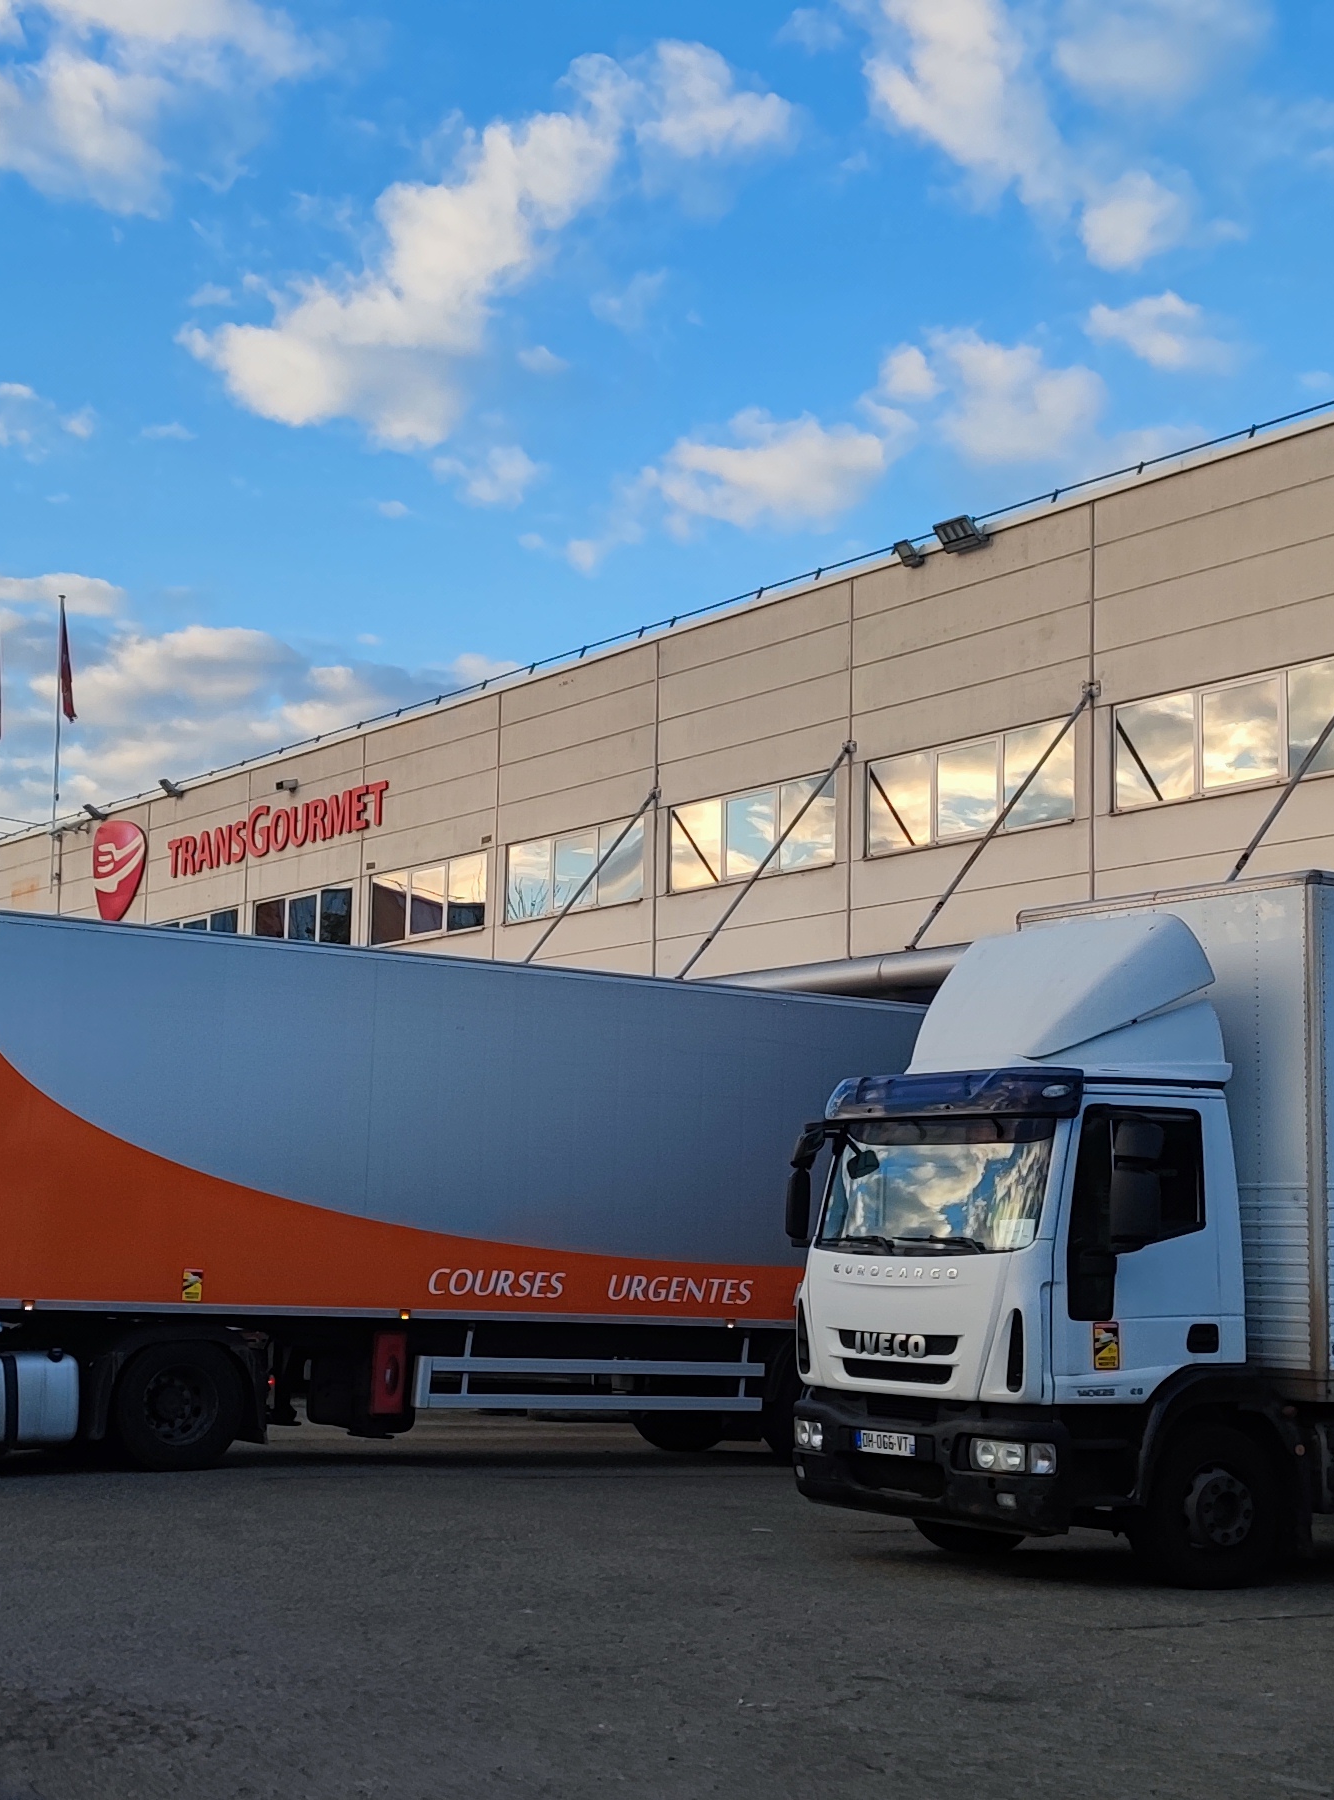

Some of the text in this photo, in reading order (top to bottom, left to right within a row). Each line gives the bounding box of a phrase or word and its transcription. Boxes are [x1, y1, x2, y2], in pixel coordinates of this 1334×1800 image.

[833, 1264, 959, 1280] EUROCARGO
[427, 1268, 754, 1305] COURSES URGENTES
[854, 1331, 927, 1359] IVECO
